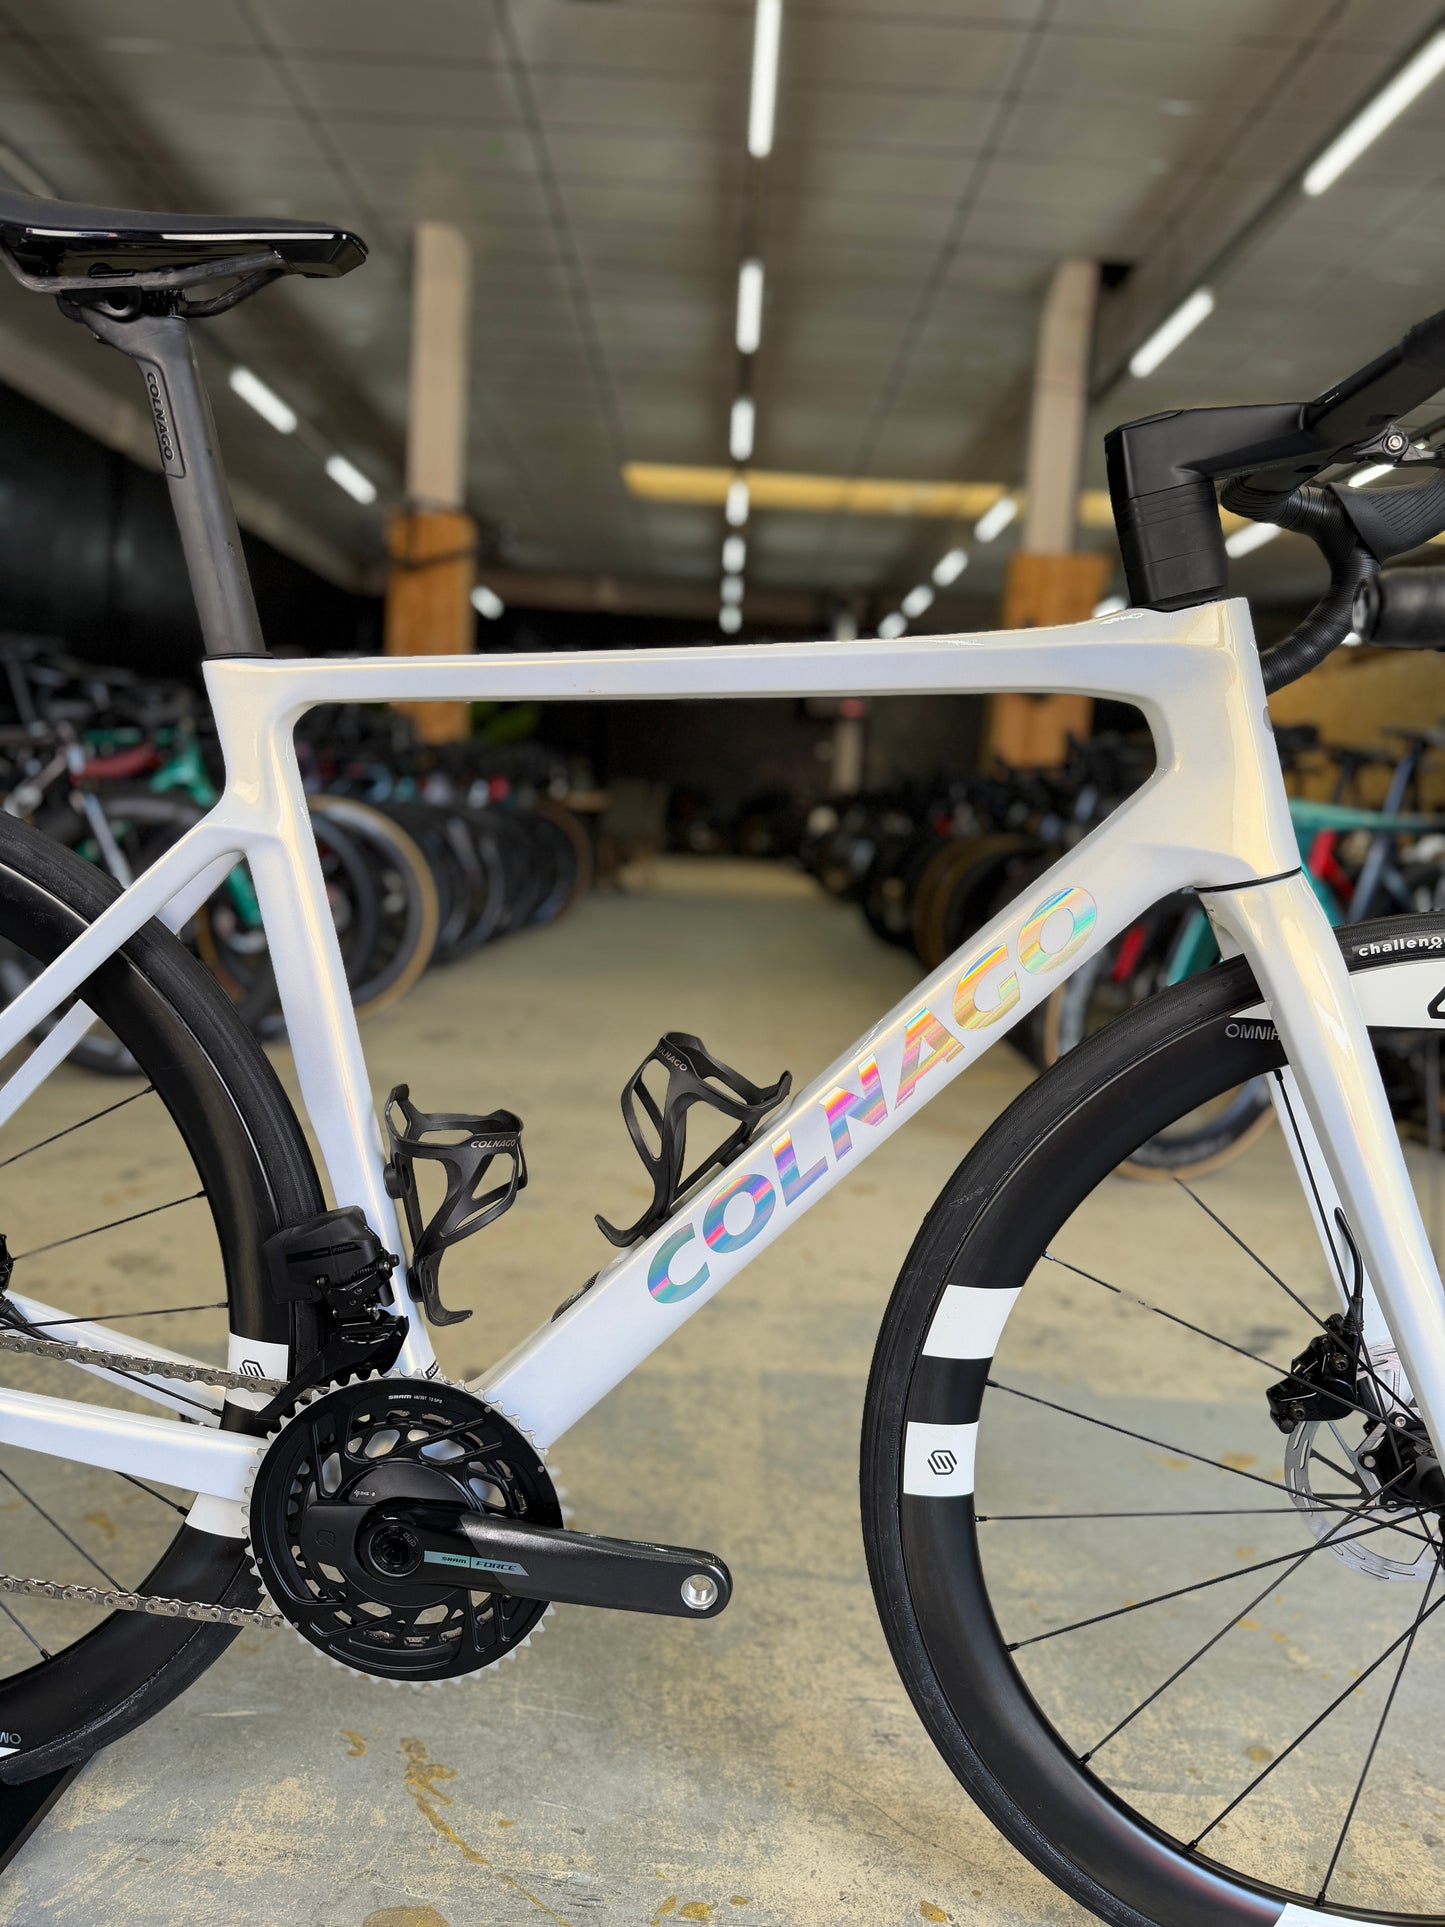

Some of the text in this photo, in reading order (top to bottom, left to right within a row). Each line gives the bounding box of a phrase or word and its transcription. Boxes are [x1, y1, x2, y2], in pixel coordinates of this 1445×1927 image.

[147, 371, 174, 461] COLNAGO
[1358, 936, 1445, 957] challeng
[647, 886, 1098, 1304] COLNAGO
[471, 1139, 517, 1149] COLNAGO
[441, 1556, 517, 1572] SRAM FORCE
